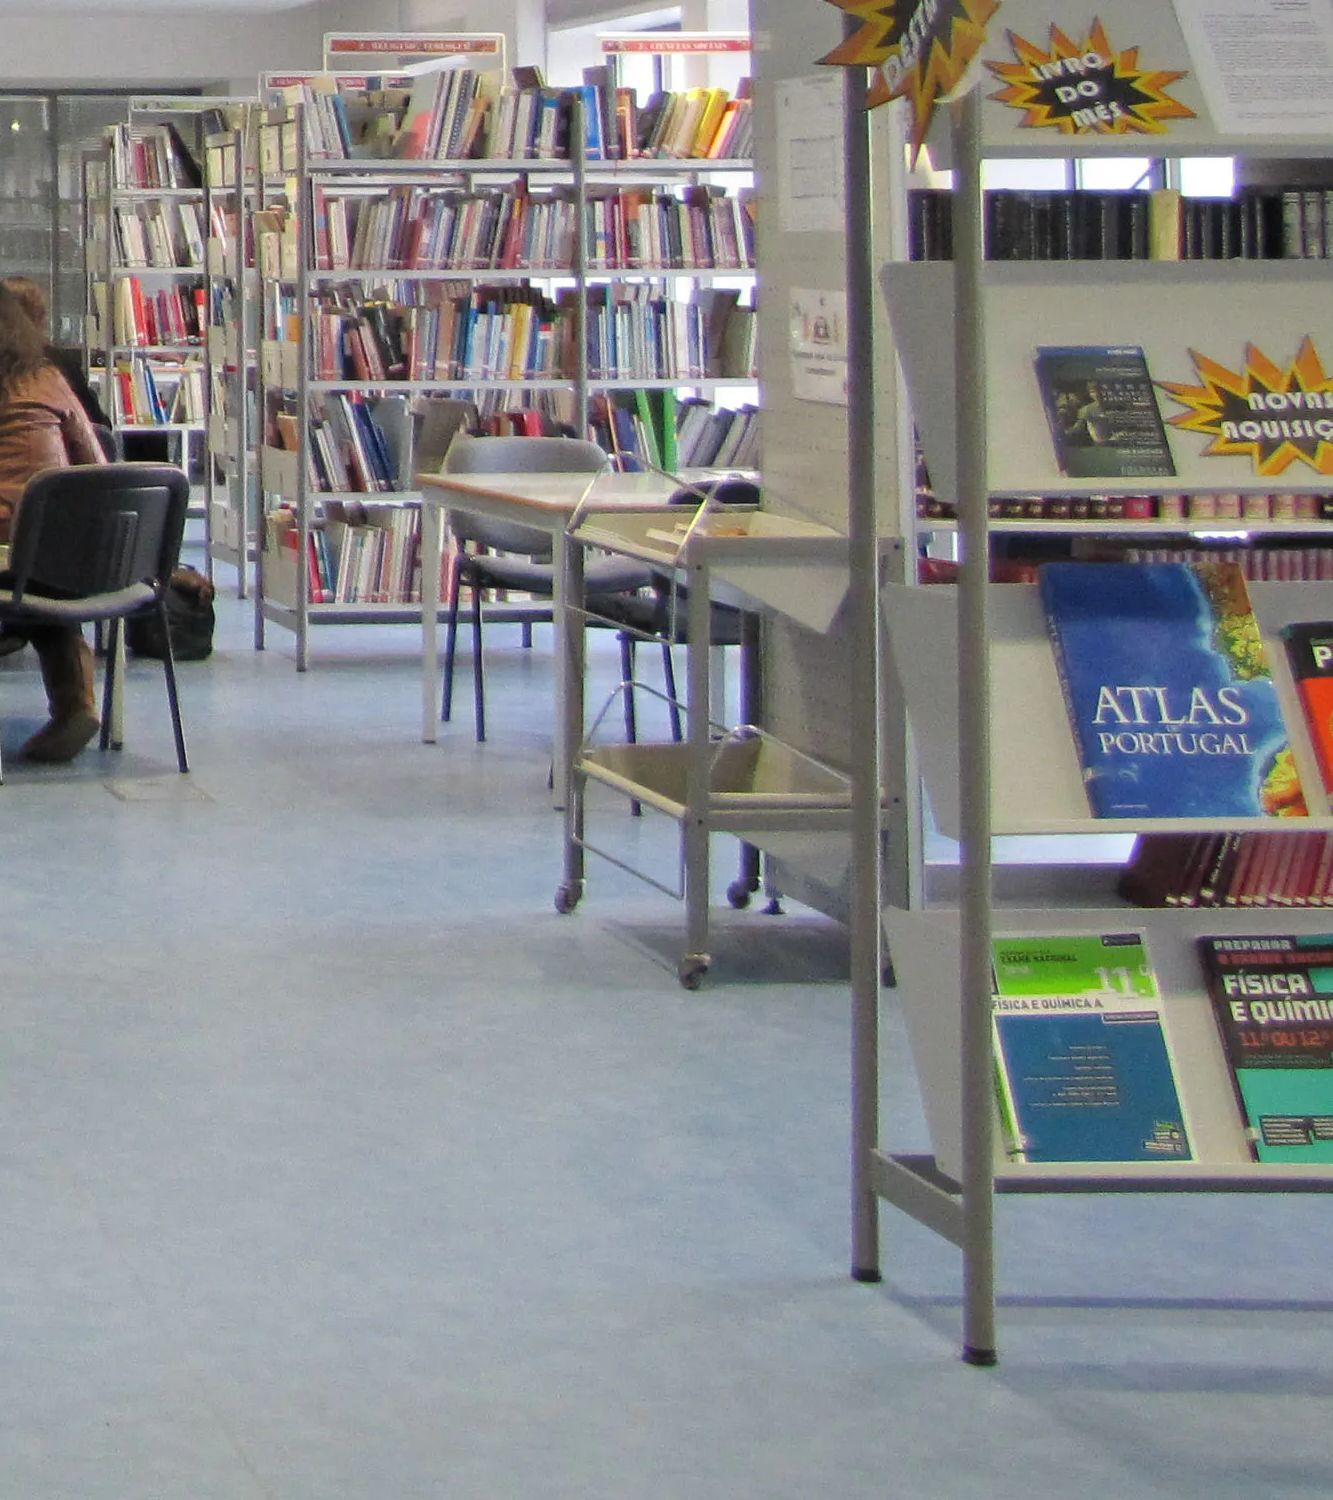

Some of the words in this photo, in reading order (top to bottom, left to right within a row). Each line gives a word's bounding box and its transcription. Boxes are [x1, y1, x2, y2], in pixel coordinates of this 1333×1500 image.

[1030, 52, 1103, 81] LIVRO
[1055, 80, 1100, 103] DO
[1091, 685, 1248, 725] ATLAS
[1097, 732, 1255, 755] PORTUGAL
[1222, 968, 1308, 994] FÍSICA
[1032, 999, 1040, 1010] E
[1043, 996, 1092, 1010] QUÍMICA
[1093, 998, 1104, 1008] A
[1229, 1000, 1249, 1021] E
[1250, 995, 1333, 1024] QUÍMI
